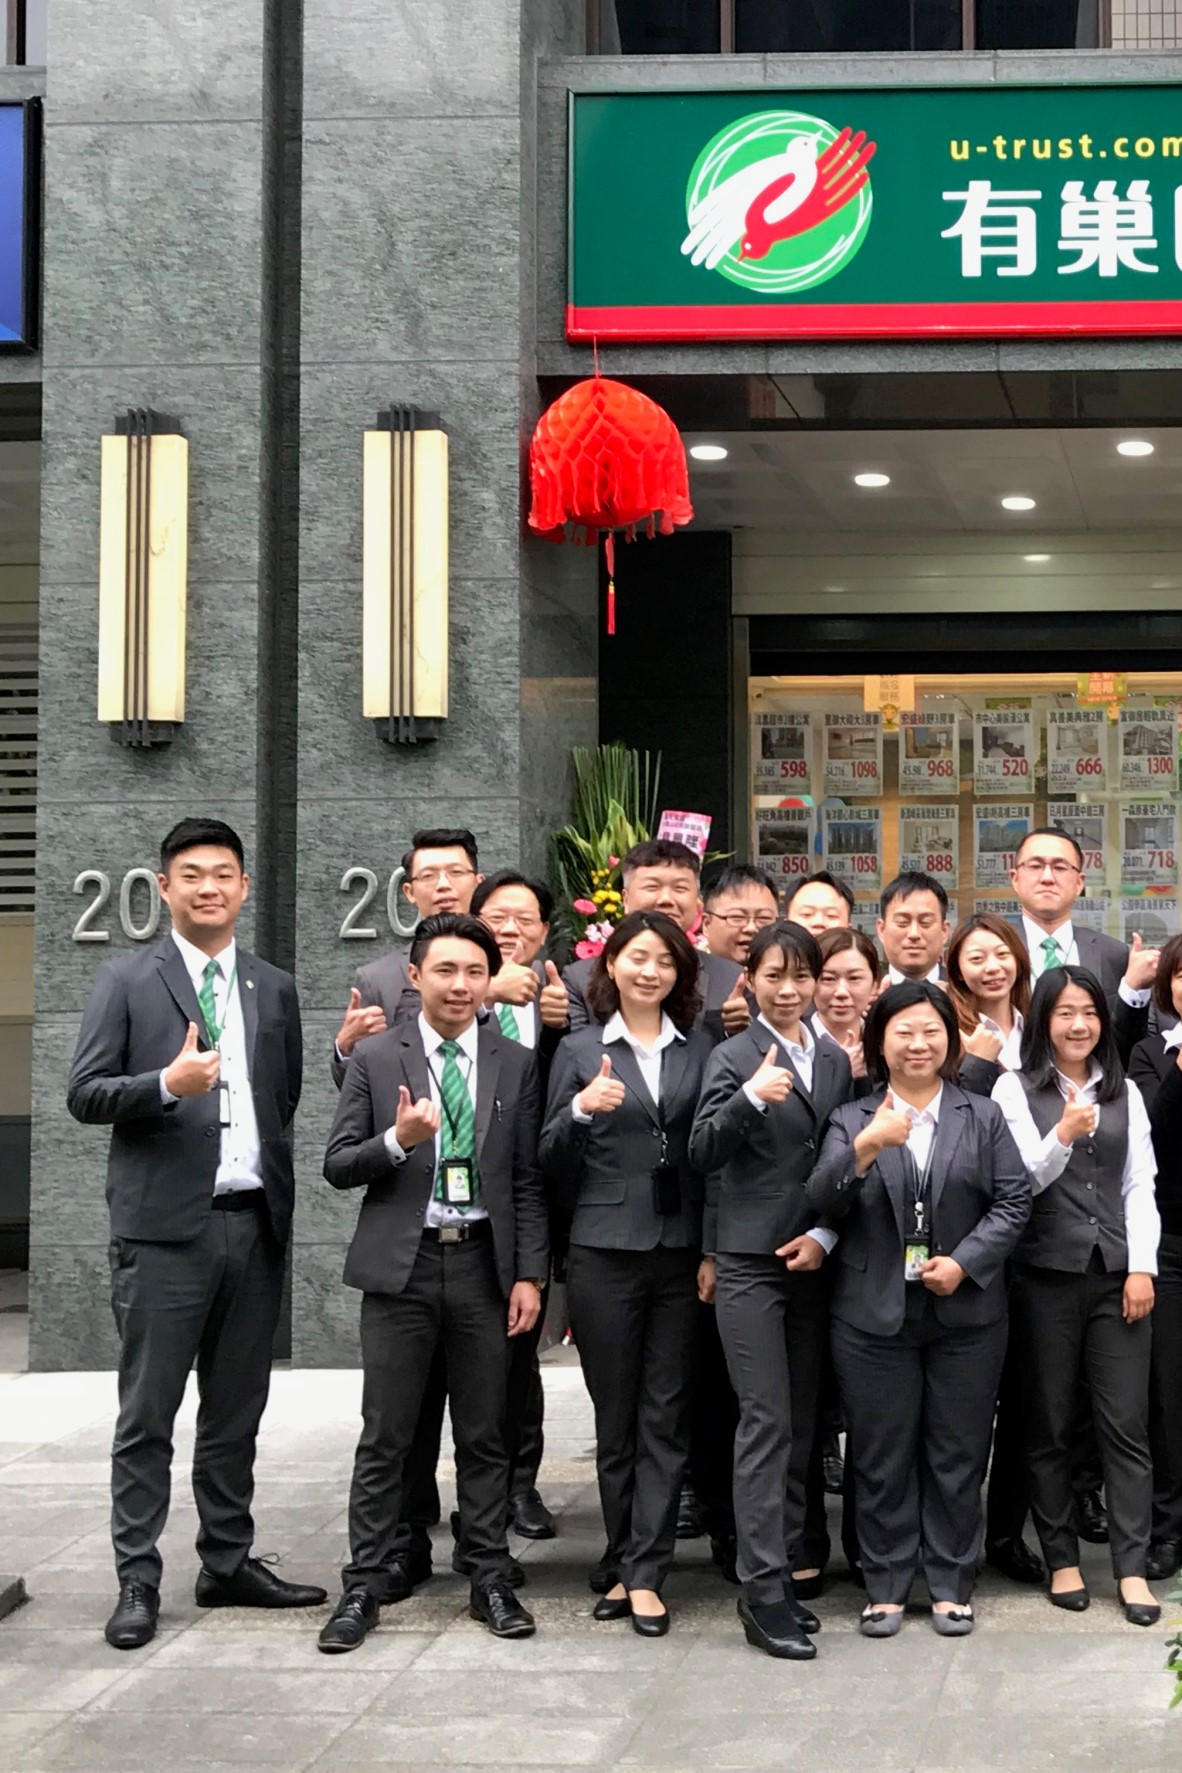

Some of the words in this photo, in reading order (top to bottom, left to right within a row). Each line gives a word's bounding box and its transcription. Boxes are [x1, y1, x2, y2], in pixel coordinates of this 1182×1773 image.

[780, 760, 807, 778] 598
[851, 761, 877, 778] 1098
[927, 759, 953, 777] 968
[1002, 759, 1028, 776] 520
[1076, 757, 1103, 775] 666
[1147, 757, 1173, 774] 1300
[782, 856, 809, 873] 850
[851, 856, 877, 873] 1058
[927, 854, 952, 872] 888
[1002, 854, 1014, 870] 11
[1084, 852, 1103, 869] 78
[1148, 851, 1174, 868] 718
[72, 867, 161, 941] 20
